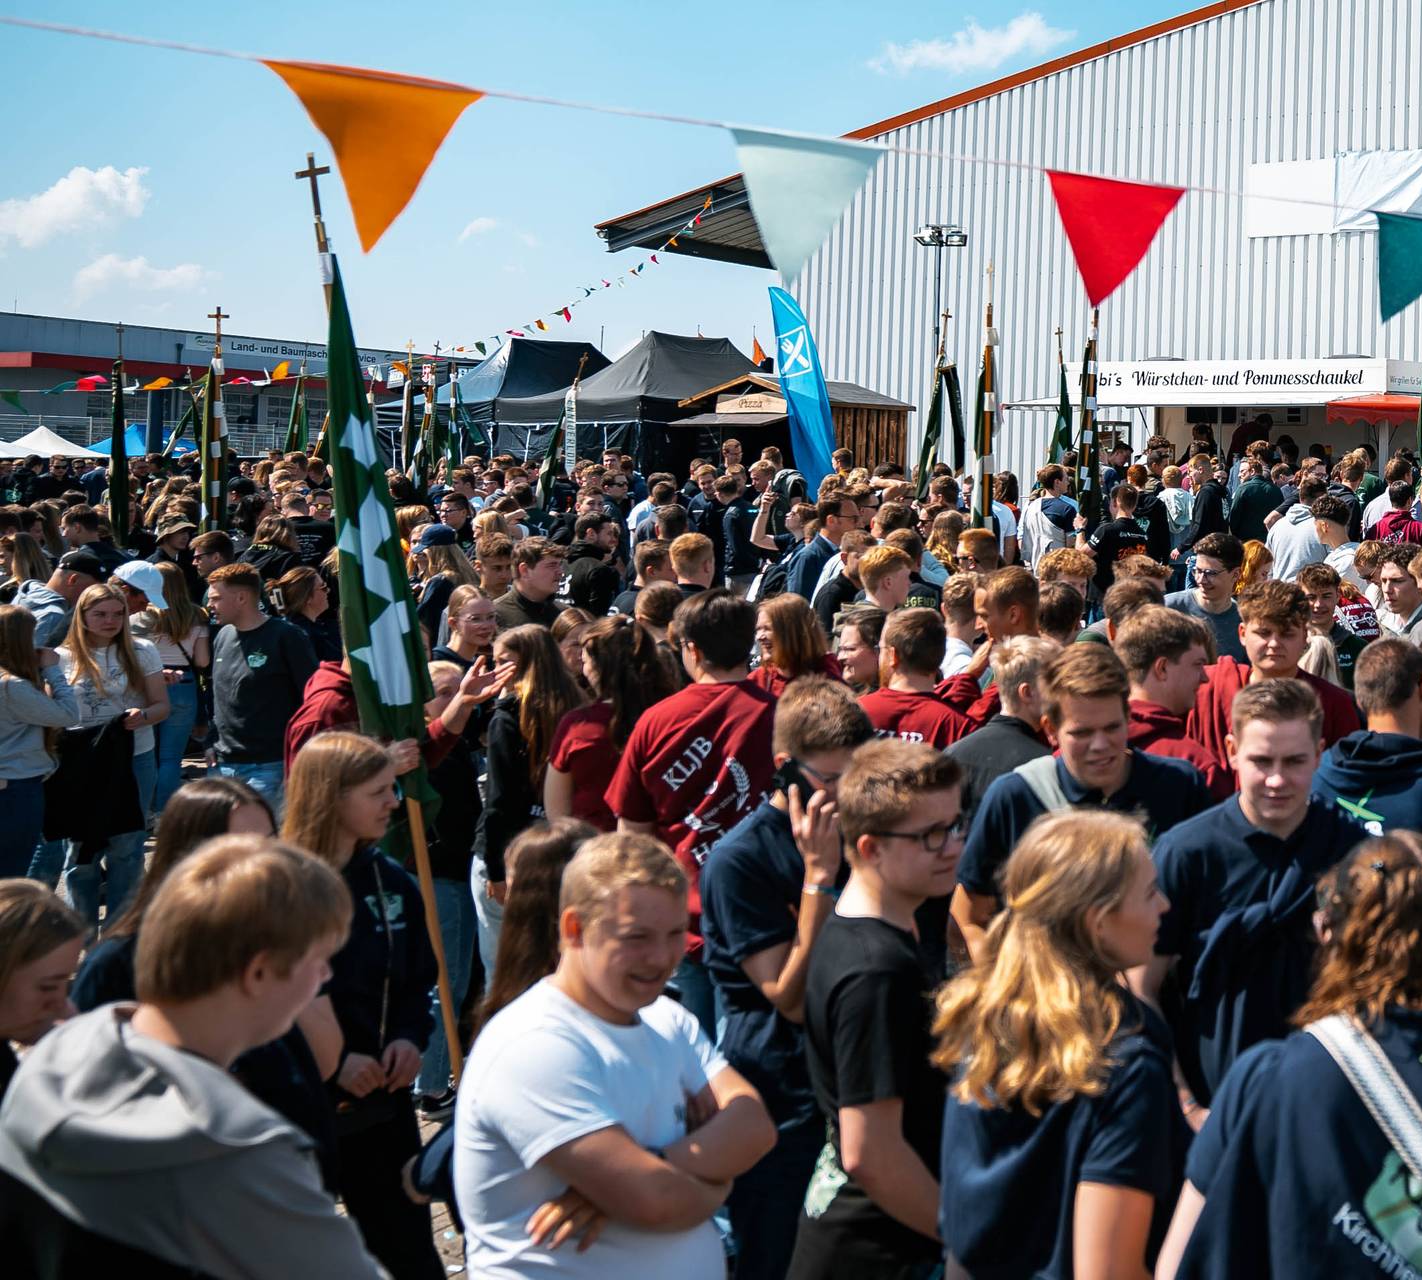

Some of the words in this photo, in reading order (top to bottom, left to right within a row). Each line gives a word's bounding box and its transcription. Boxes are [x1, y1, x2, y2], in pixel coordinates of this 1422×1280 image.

[231, 341, 258, 352] Land-
[260, 345, 279, 354] und
[1132, 370, 1208, 386] Würstchen-
[1212, 370, 1239, 386] und
[1243, 369, 1364, 386] Pommesschaukel
[662, 736, 713, 791] KLJB
